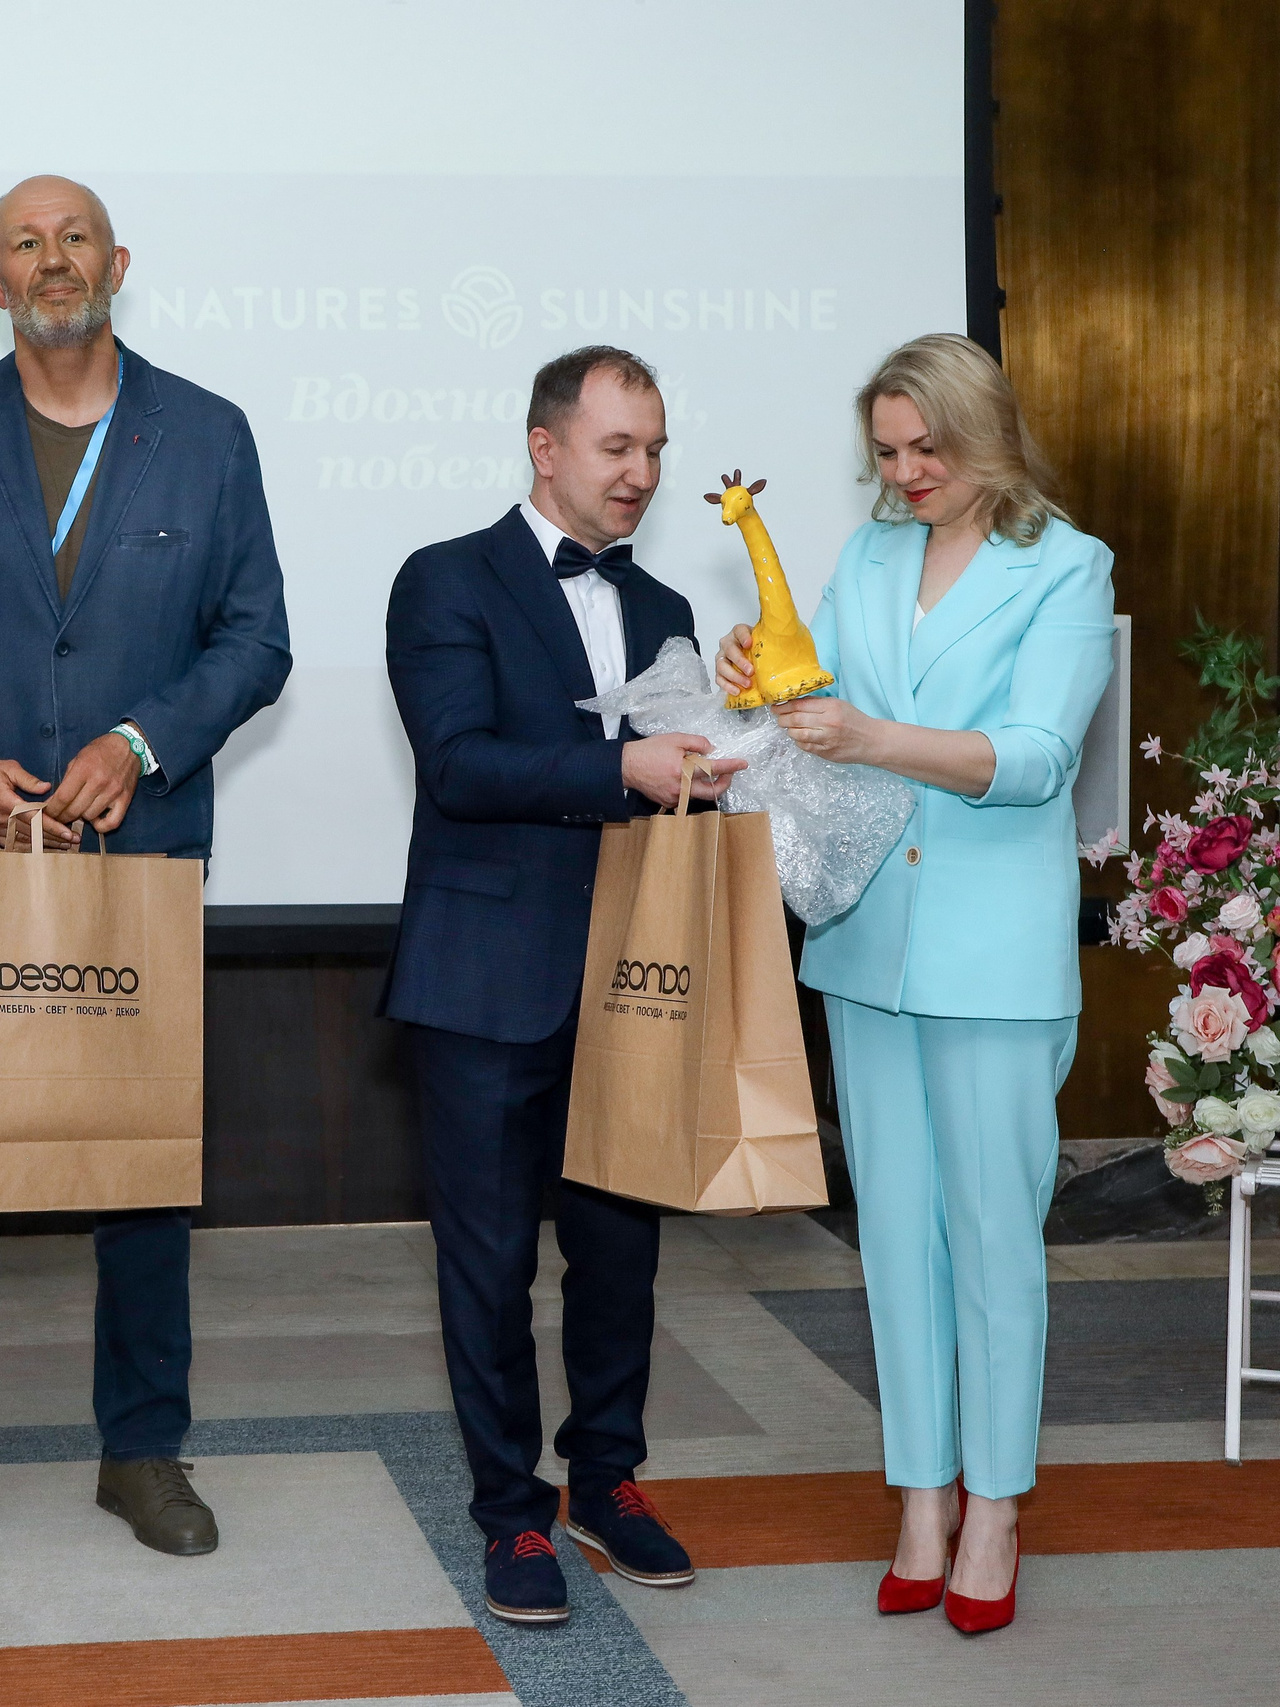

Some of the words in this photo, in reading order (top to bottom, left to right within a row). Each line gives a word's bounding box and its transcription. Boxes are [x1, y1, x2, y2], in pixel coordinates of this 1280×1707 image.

[149, 286, 420, 332] NATURES
[540, 286, 838, 332] SUNSHINE
[286, 370, 708, 431] Вдохной,
[319, 444, 683, 490] побеж!
[45, 1005, 67, 1015] СВЕТ
[76, 1006, 107, 1017] ПОСУДА
[115, 1007, 140, 1018] ДЕКОР
[616, 1003, 630, 1014] СВЕТ
[636, 1006, 663, 1019] ПОСУДА
[669, 1010, 687, 1021] ДЕКОР
